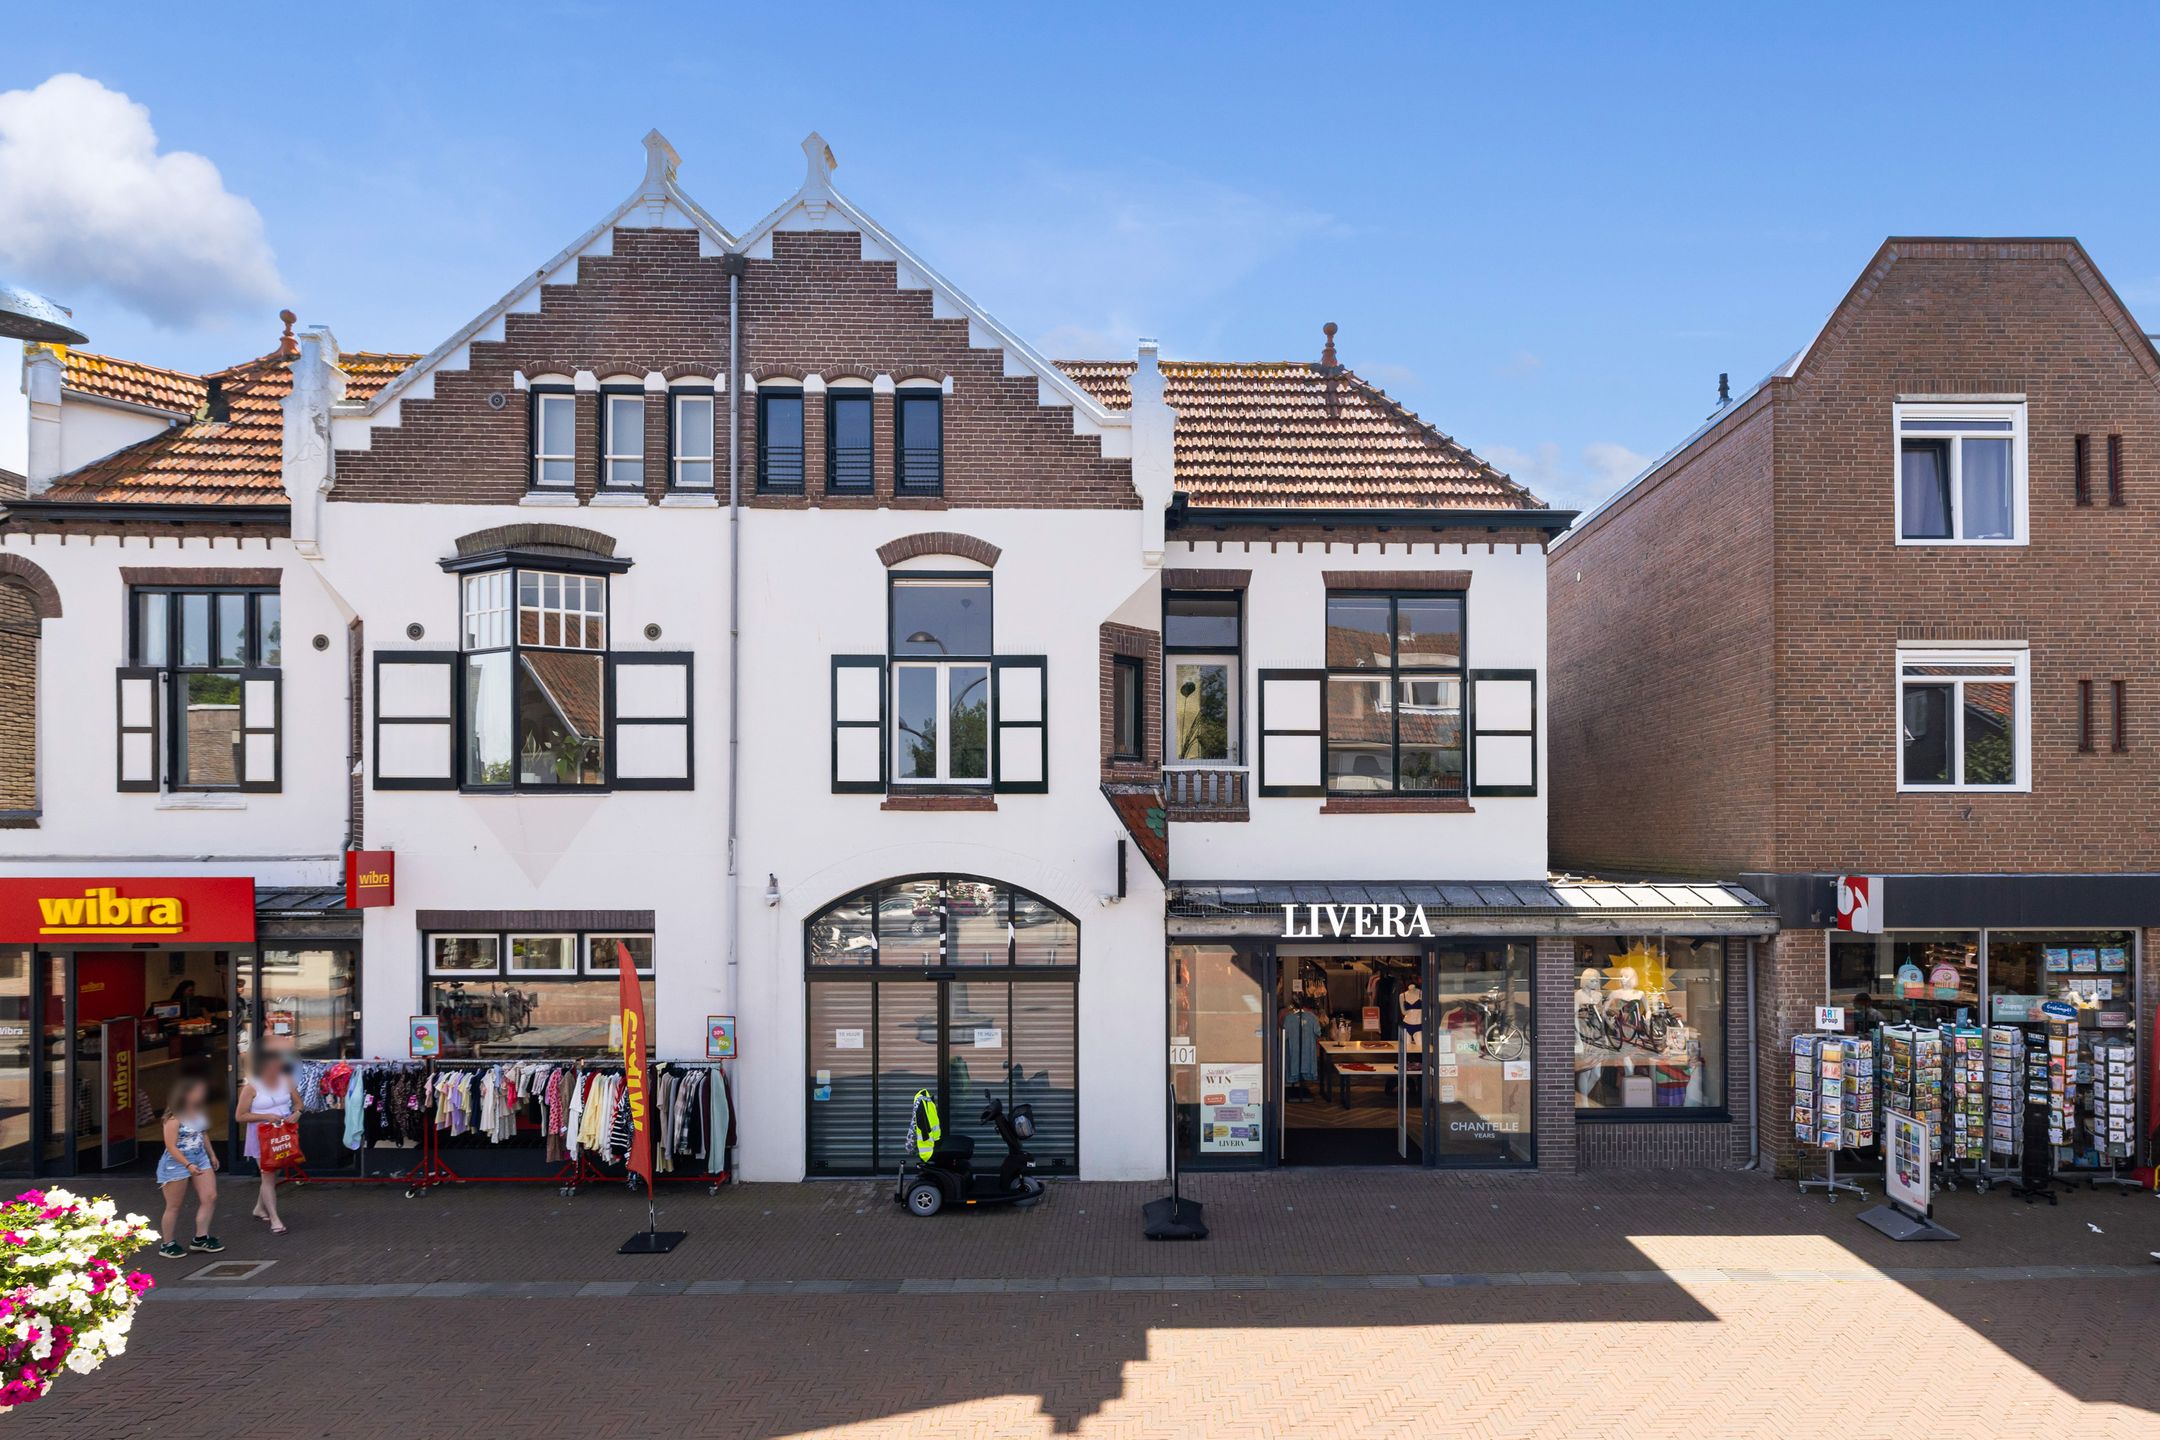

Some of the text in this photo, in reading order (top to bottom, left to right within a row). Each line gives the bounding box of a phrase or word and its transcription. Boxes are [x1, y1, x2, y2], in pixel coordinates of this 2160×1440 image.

[359, 870, 390, 885] wibra
[38, 887, 183, 925] wibra
[1280, 903, 1436, 938] LIVERA
[1821, 1008, 1838, 1018] ART
[1821, 1017, 1838, 1025] group
[1171, 1047, 1195, 1063] 101
[112, 1051, 128, 1111] wibra
[1206, 1076, 1231, 1084] WIN
[1450, 1122, 1519, 1131] CHANTELLE
[271, 1141, 292, 1153] WITH
